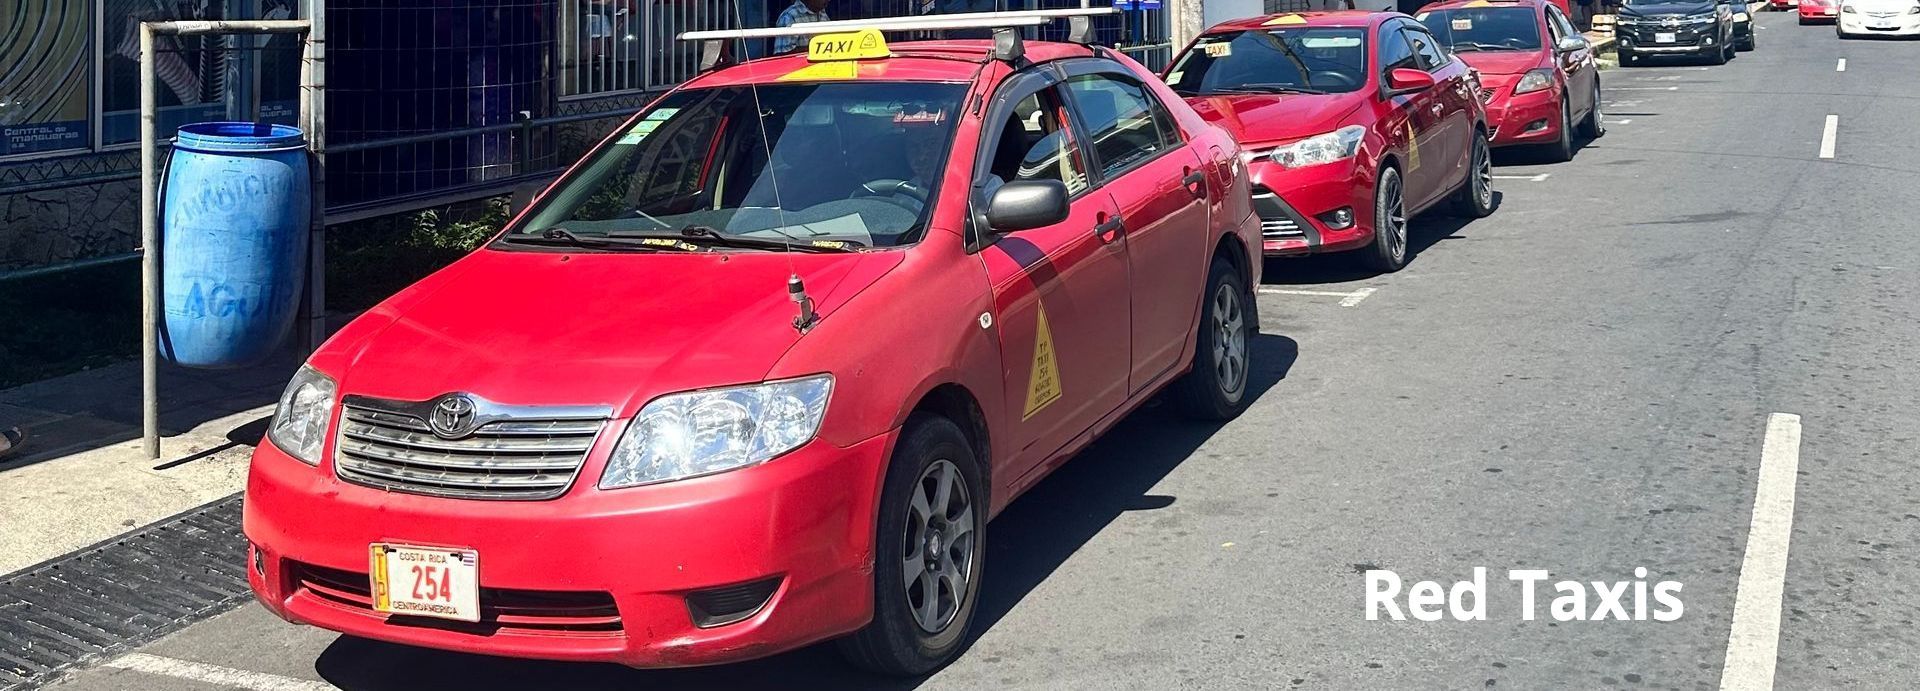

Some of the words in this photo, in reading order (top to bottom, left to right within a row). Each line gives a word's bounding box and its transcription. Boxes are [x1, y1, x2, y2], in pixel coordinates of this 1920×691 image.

[815, 40, 854, 54] TAXI
[1207, 45, 1226, 55] TAXI
[399, 552, 425, 561] COSTA
[428, 554, 448, 564] RICA
[376, 552, 386, 606] TP
[412, 565, 451, 602] 254
[393, 600, 459, 614] CENTROAMERICA
